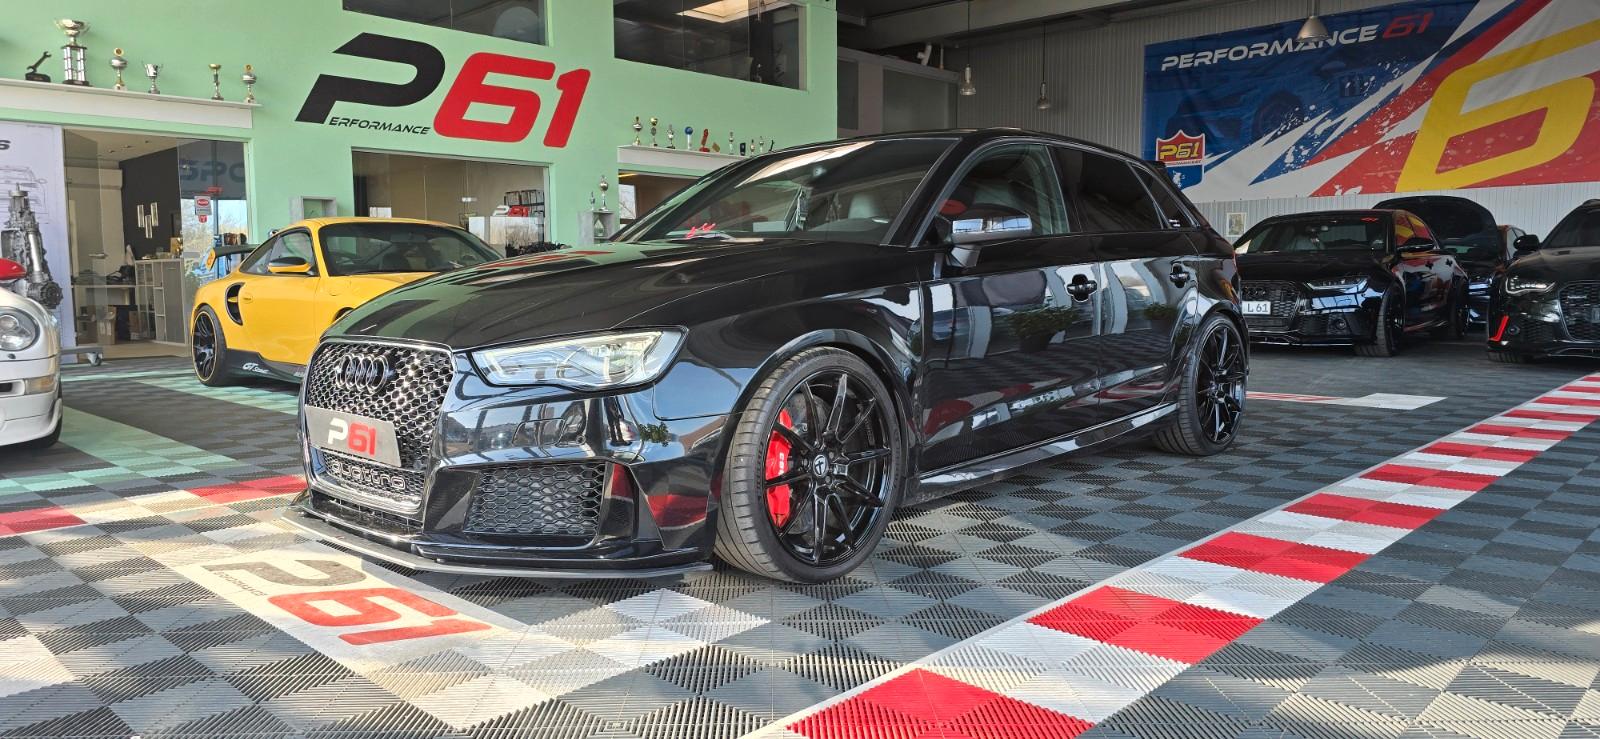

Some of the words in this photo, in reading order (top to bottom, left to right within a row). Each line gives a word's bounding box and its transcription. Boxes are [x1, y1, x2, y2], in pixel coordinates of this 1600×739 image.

[1161, 24, 1380, 72] PERFORMANCE
[1383, 12, 1434, 39] 61
[295, 32, 591, 148] P61
[1160, 142, 1200, 160] P61
[1256, 303, 1269, 313] 61
[327, 417, 376, 456] P61
